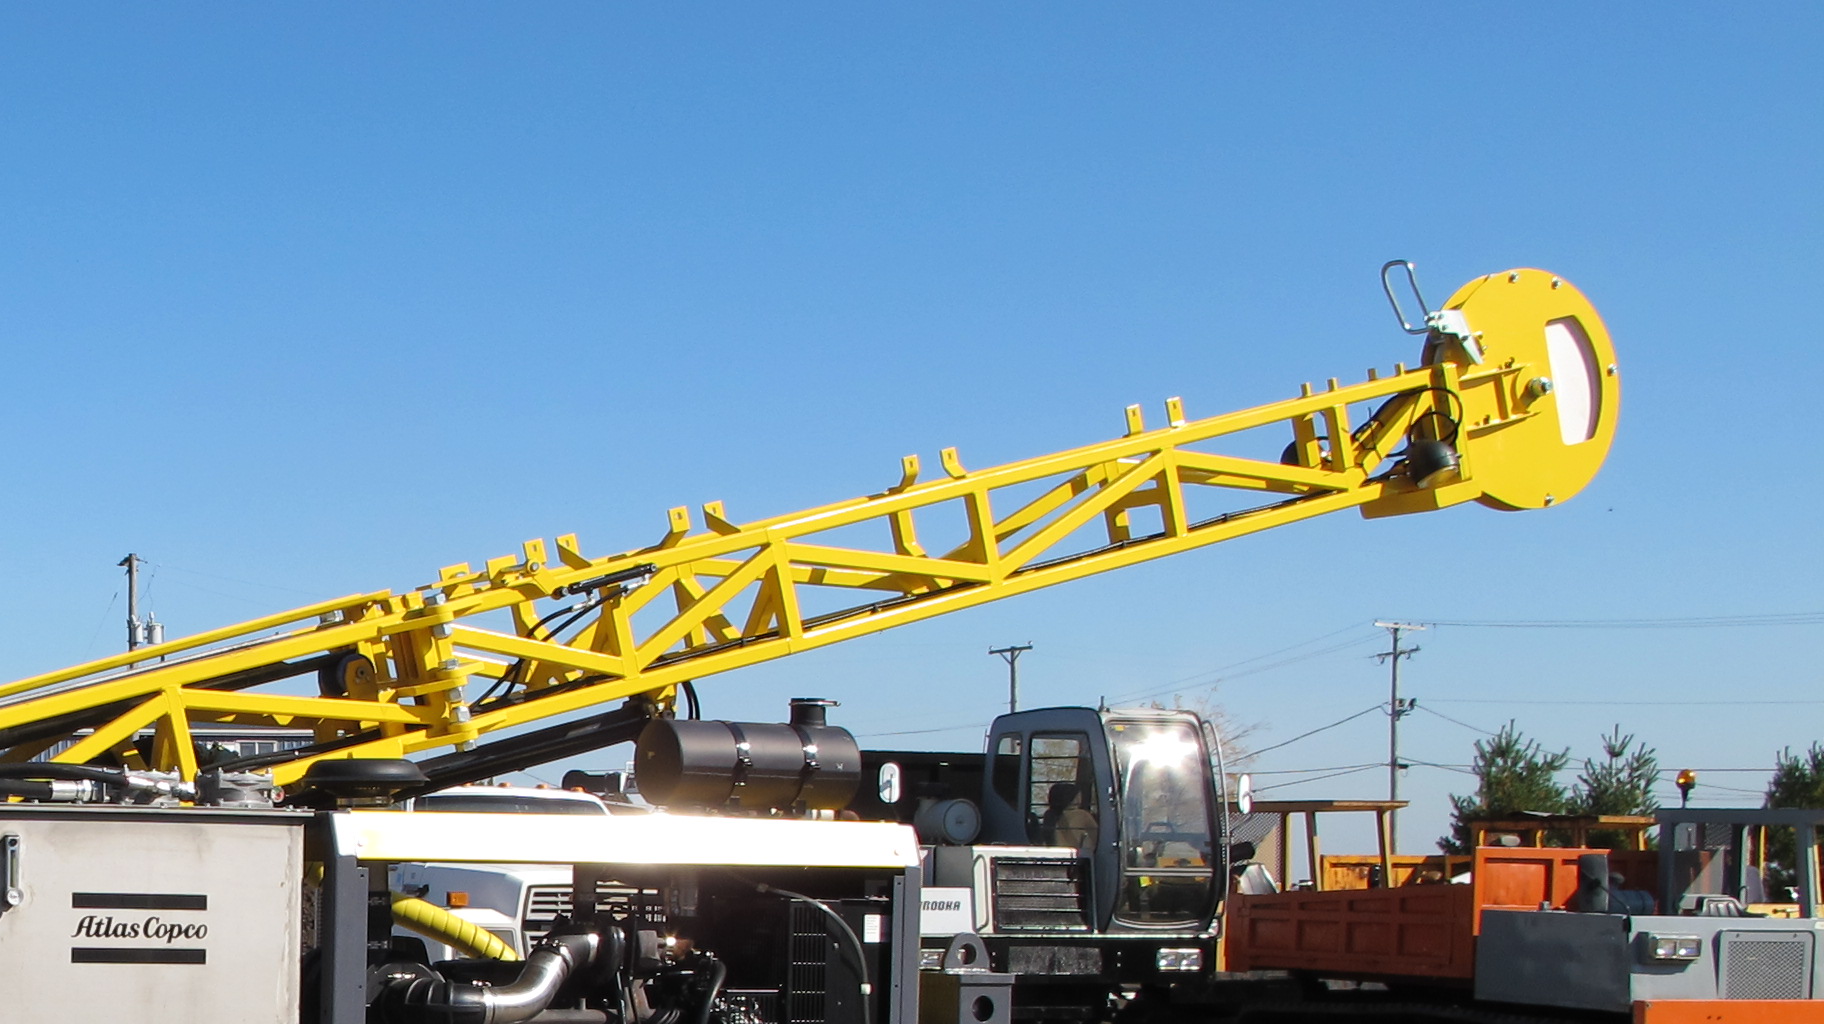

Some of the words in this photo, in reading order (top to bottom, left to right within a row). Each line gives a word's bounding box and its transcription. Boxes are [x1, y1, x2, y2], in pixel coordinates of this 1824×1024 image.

[920, 900, 961, 911] ROOKA
[71, 915, 141, 939] Atlas
[143, 916, 208, 944] Copco
